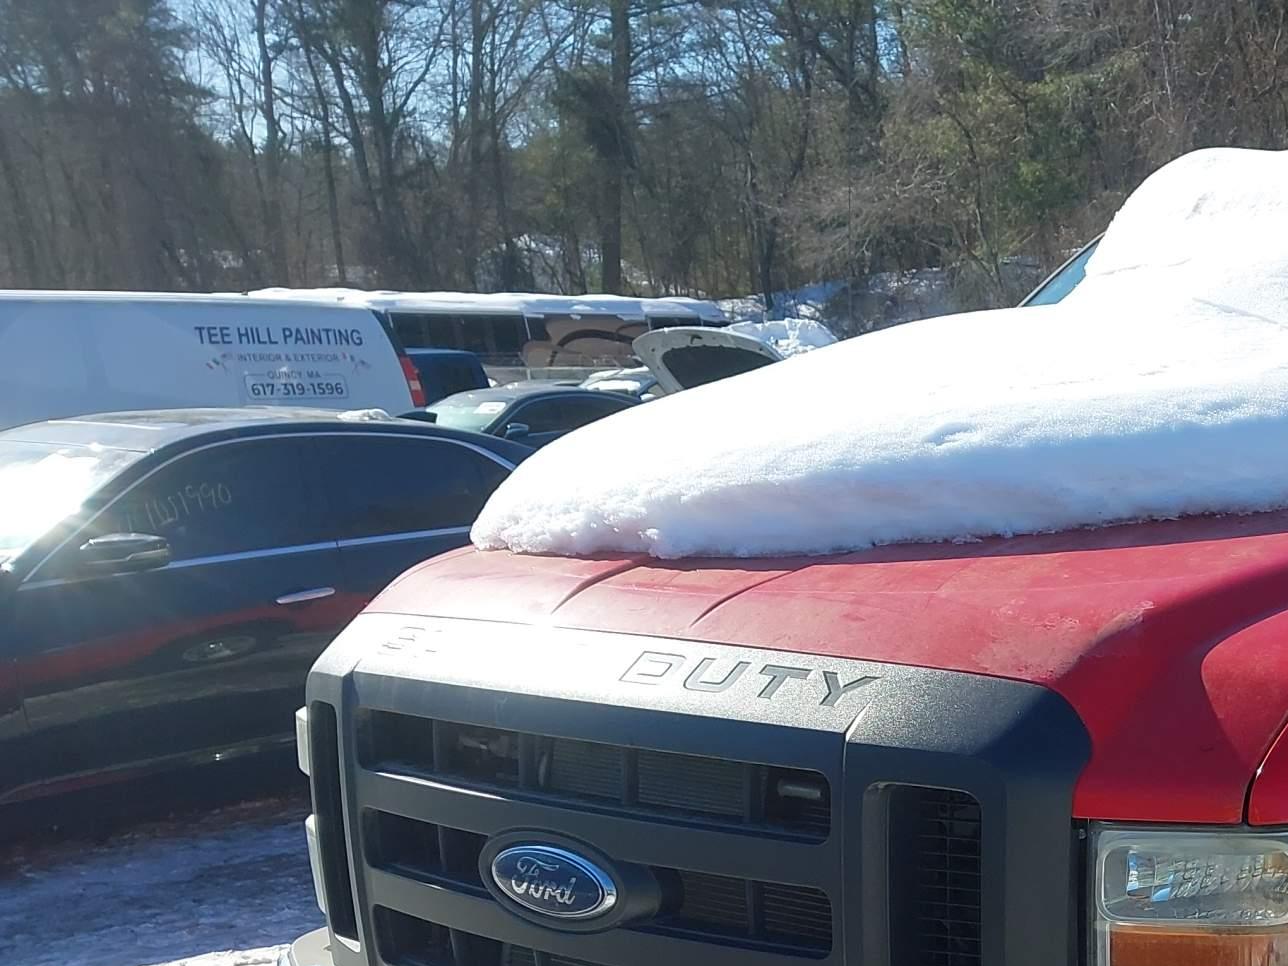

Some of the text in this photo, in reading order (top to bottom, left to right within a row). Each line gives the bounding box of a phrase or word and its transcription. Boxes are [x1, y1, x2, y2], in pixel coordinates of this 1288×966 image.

[194, 326, 364, 346] TEE HILL PAINTING
[237, 353, 340, 363] INTERIOR & EXTERIOR
[307, 370, 321, 379] MA
[250, 382, 345, 396] 617-319-1596
[618, 650, 881, 707] DUTY
[511, 856, 577, 905] Ford
